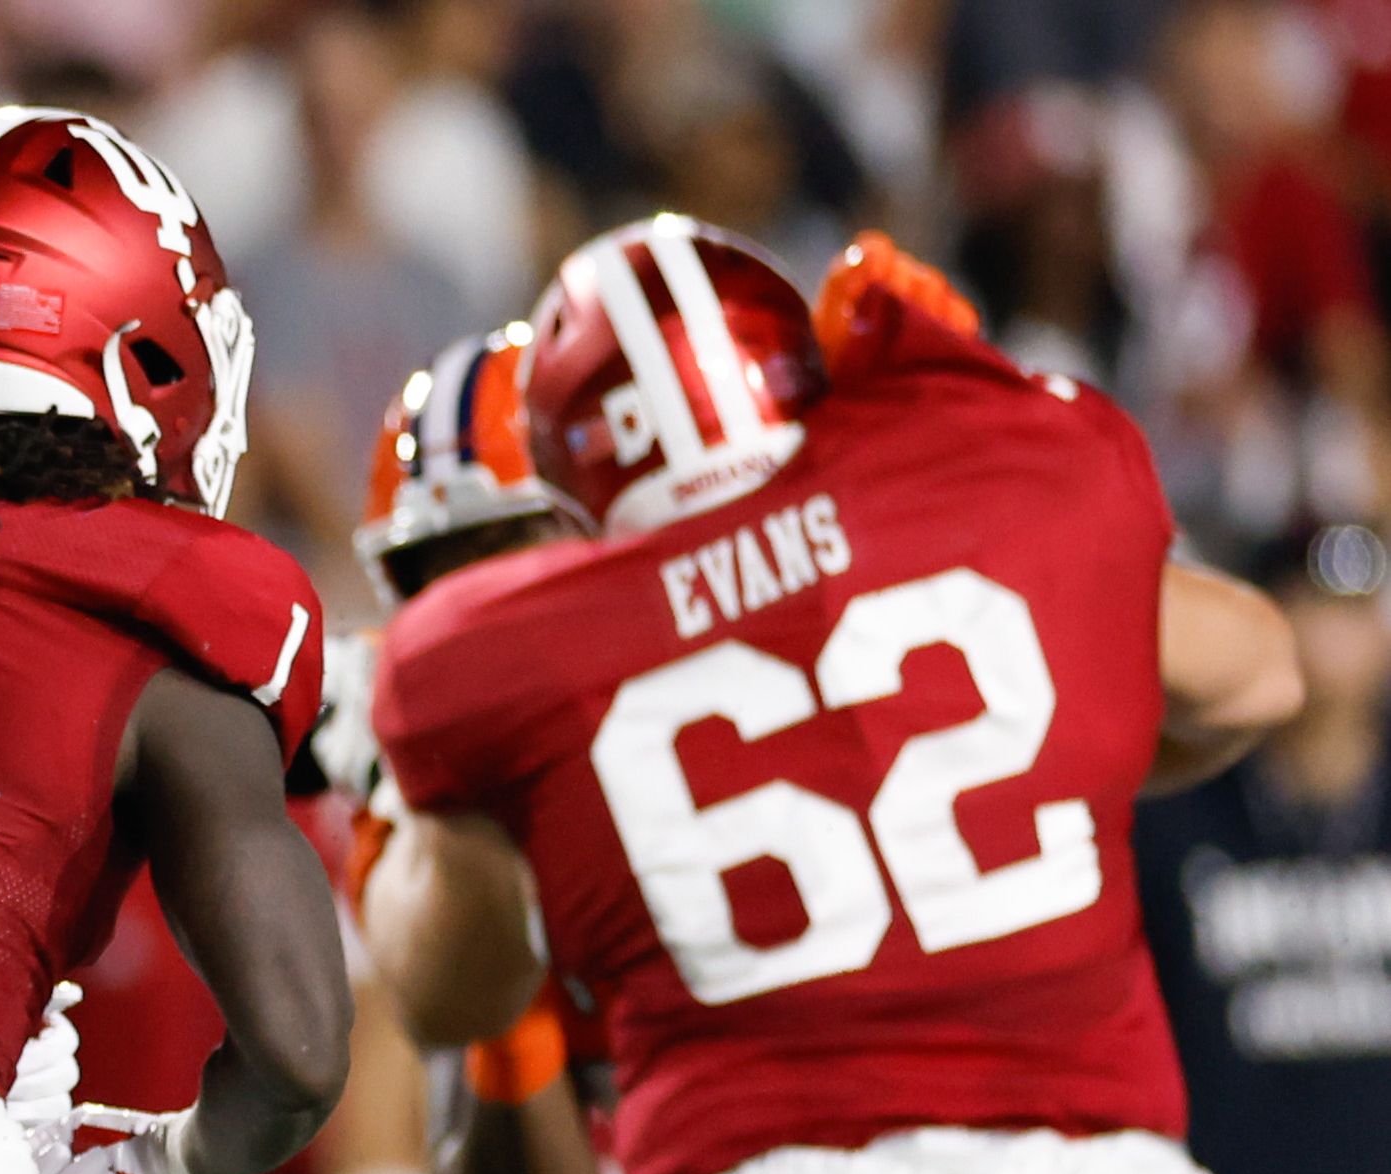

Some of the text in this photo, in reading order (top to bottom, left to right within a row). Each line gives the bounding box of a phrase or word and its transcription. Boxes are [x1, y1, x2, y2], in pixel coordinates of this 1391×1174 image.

[660, 493, 852, 639] EVANS
[251, 601, 310, 707] 1
[590, 567, 1104, 1006] 62
